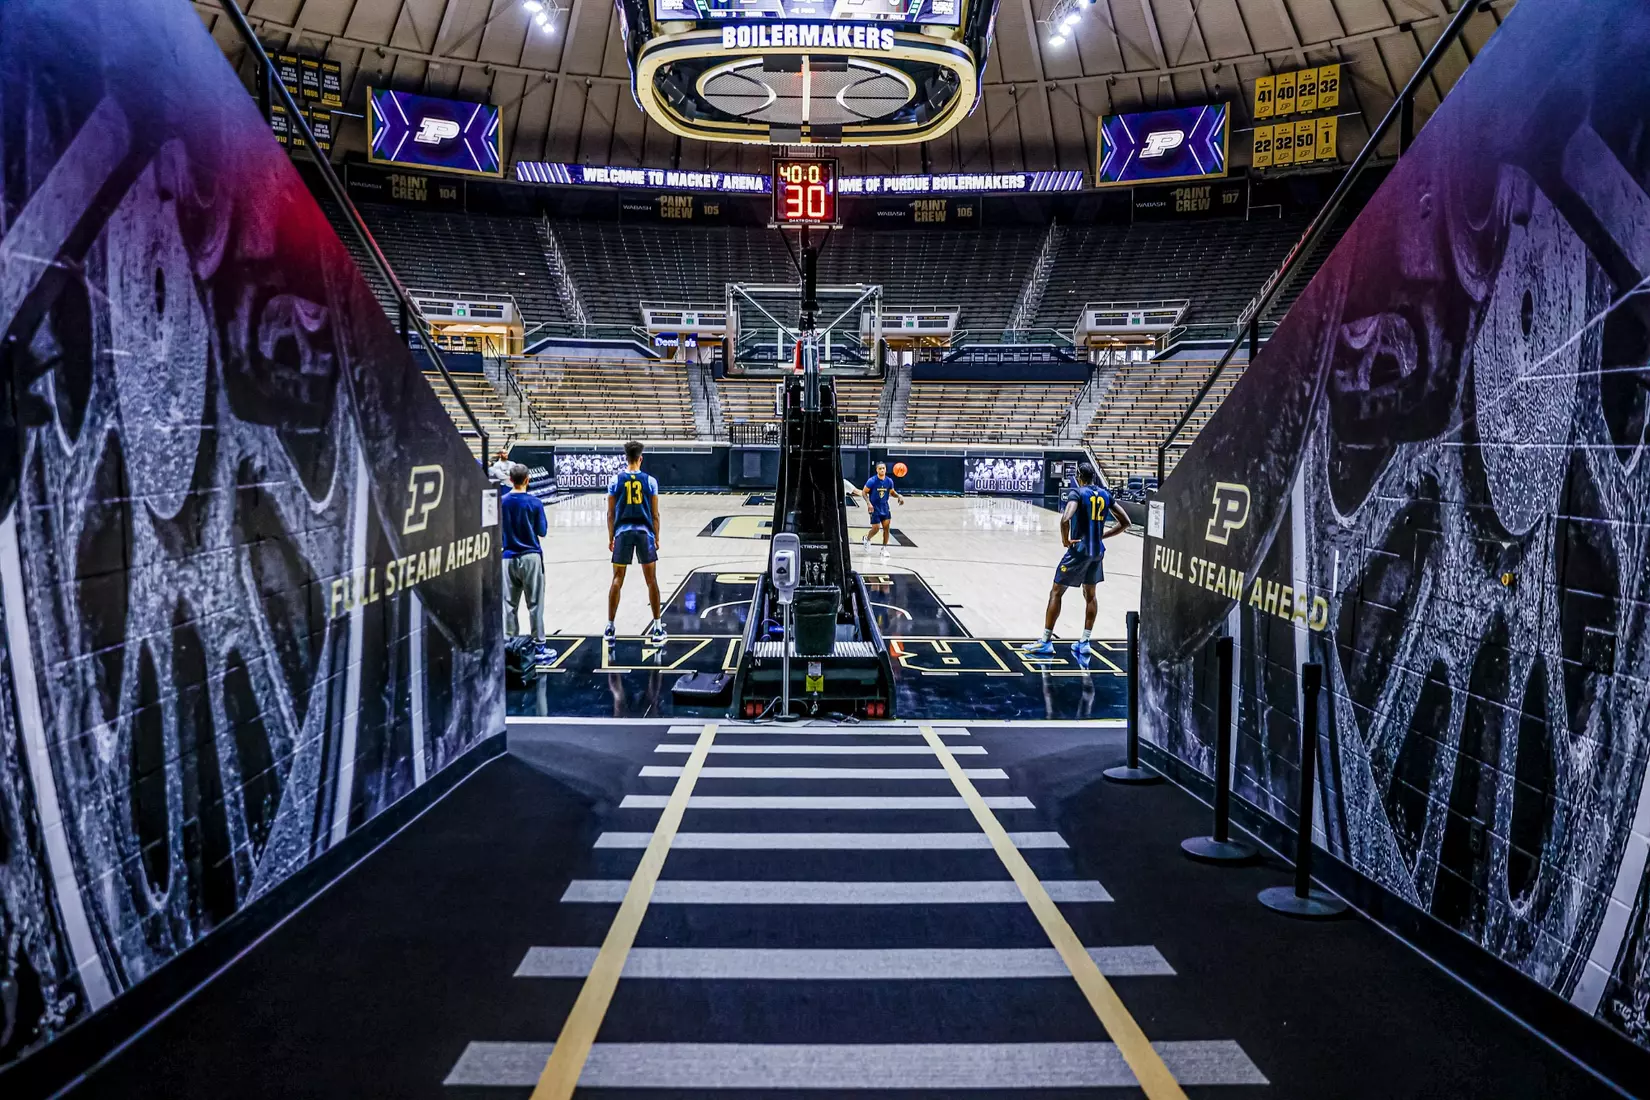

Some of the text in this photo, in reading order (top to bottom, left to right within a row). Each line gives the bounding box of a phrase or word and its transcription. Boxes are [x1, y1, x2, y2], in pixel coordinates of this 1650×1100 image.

[723, 24, 894, 50] BOILERMAKERS
[1277, 86, 1294, 100] 40
[1299, 82, 1316, 97] 22
[1320, 79, 1338, 93] 32
[1258, 90, 1272, 103] 41
[414, 117, 460, 144] P
[1324, 131, 1329, 143] 1
[1139, 130, 1184, 158] P
[1255, 140, 1271, 153] 22
[1276, 137, 1292, 150] 32
[1297, 133, 1313, 147] 50
[392, 174, 428, 189] PAINT
[583, 168, 764, 190] WELCOME TO MACKEY ARENA
[865, 178, 880, 192] OF
[884, 176, 930, 192] PURDUE
[932, 175, 1026, 190] BOILERMAKERS
[392, 186, 428, 201] CREW
[439, 188, 456, 200] 104
[1175, 186, 1211, 200] PAINT
[1222, 193, 1239, 204] 107
[661, 196, 693, 207] PAINT
[784, 185, 825, 218] 30
[914, 200, 947, 211] PAINT
[1175, 198, 1211, 212] CREW
[661, 207, 693, 219] CREW
[704, 205, 720, 215] 105
[914, 210, 947, 222] CREW
[957, 207, 973, 217] 106
[557, 474, 596, 487] WHOSE
[975, 479, 1033, 491] OUR HOUSE
[402, 464, 444, 535] P
[624, 481, 642, 505] 13
[1090, 495, 1105, 520] 12
[1205, 482, 1250, 546] P
[330, 532, 490, 618] FULL STEAM AHEAD
[1154, 544, 1328, 632] FULL STEAM AHEAD
